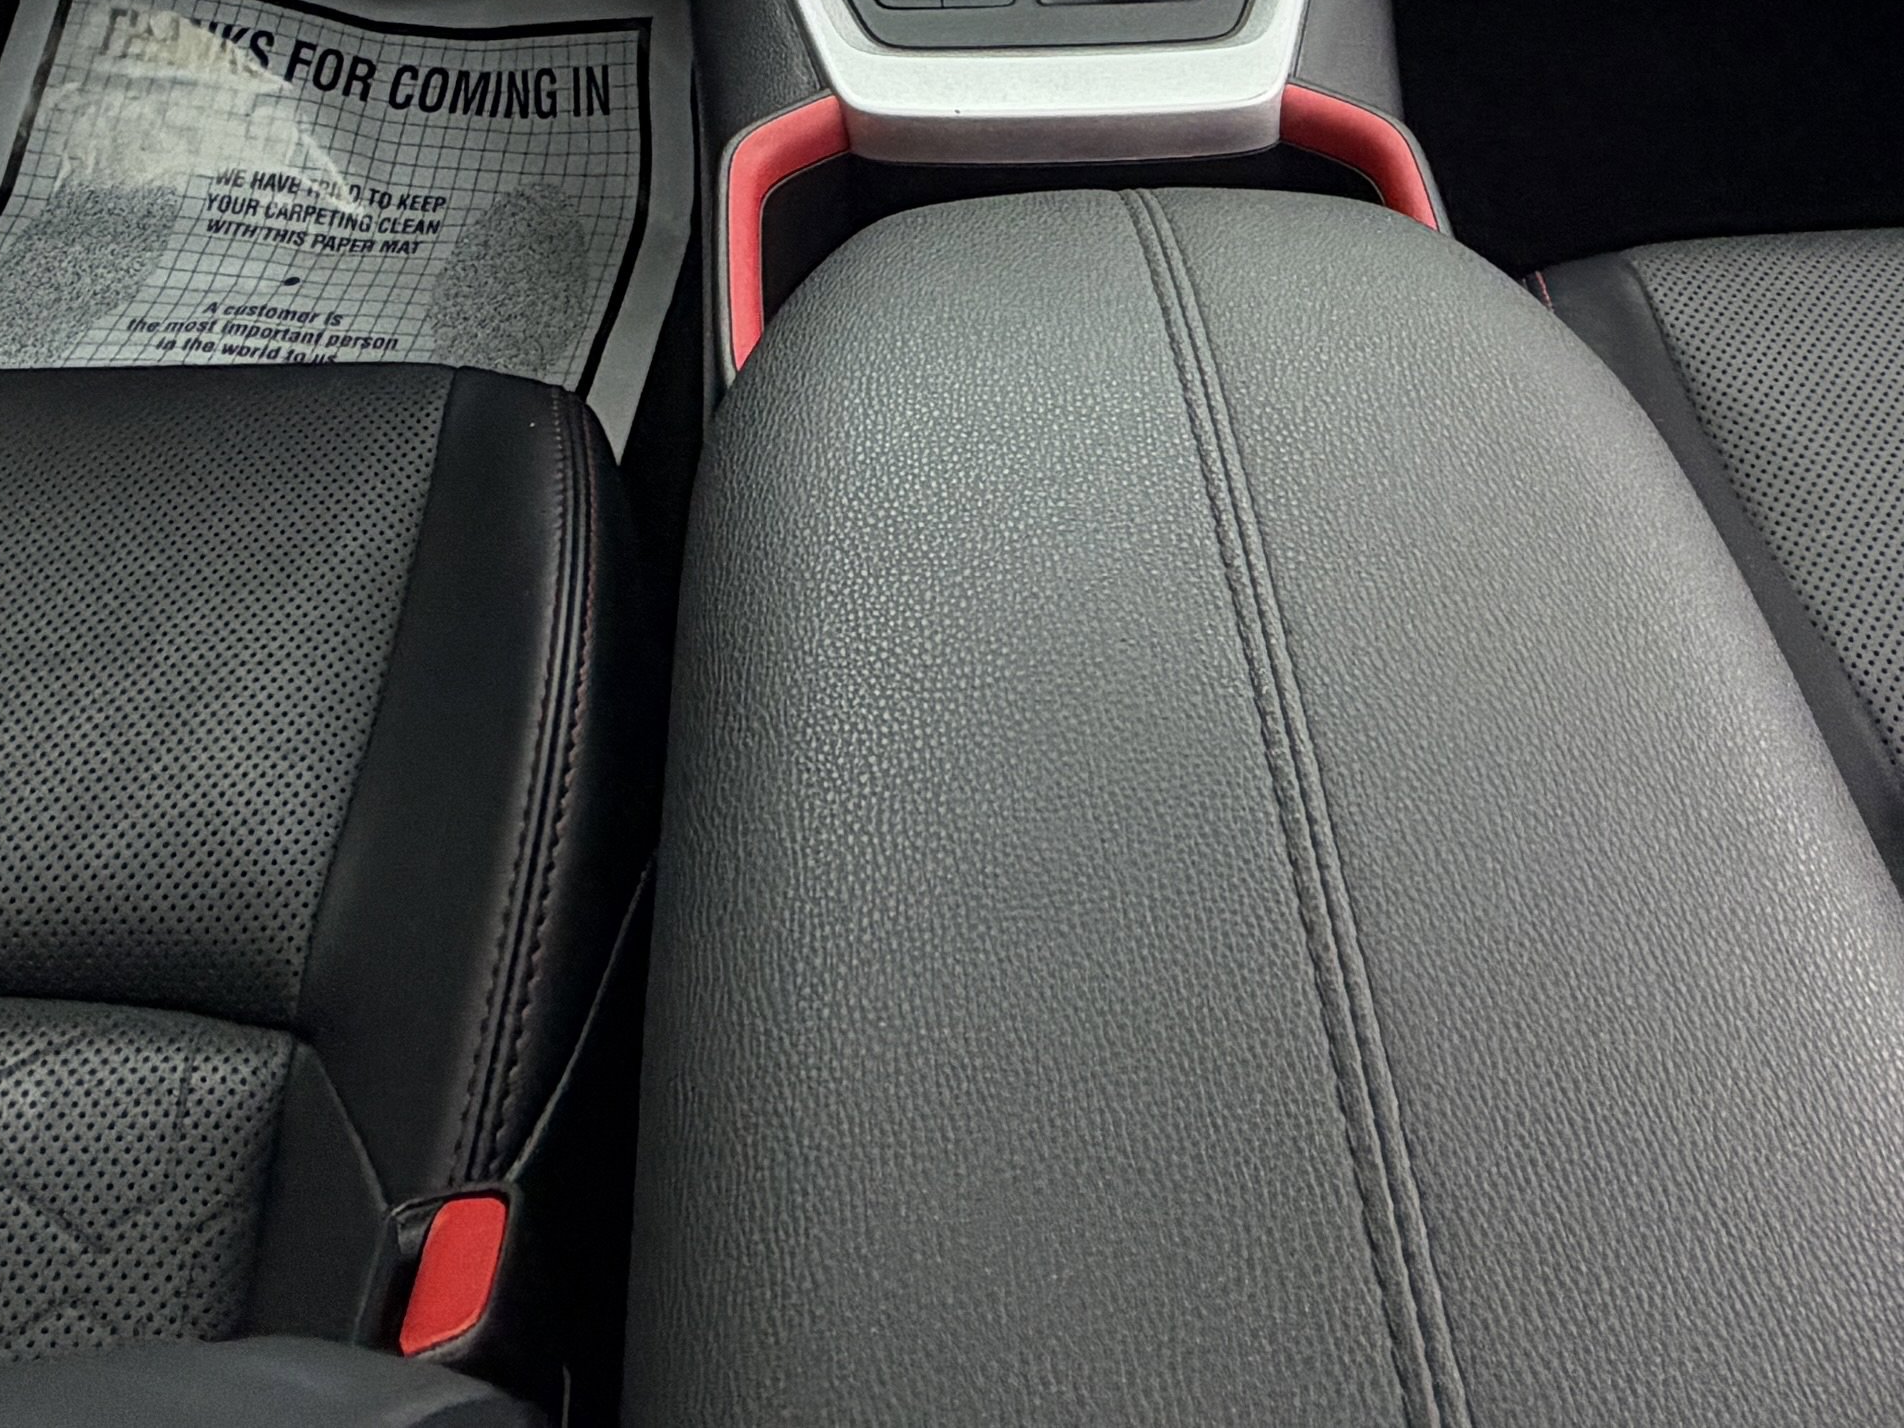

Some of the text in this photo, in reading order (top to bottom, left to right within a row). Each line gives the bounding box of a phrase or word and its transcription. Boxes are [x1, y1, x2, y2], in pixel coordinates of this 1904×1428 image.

[283, 39, 377, 103] FOR
[387, 64, 558, 120] COMING
[572, 64, 610, 117] IN
[215, 168, 247, 188] WE
[250, 171, 303, 194] HAVE
[368, 188, 392, 209] TO
[397, 193, 447, 213] KEEP
[206, 193, 441, 235] YOUR CARPETING CLEAN
[206, 218, 424, 255] WITH THIS PAPER MAT
[203, 301, 343, 327] A customer is
[127, 318, 399, 352] the most important person
[155, 336, 175, 351] in
[181, 337, 214, 353] the
[221, 343, 286, 361] world
[286, 350, 306, 363] to
